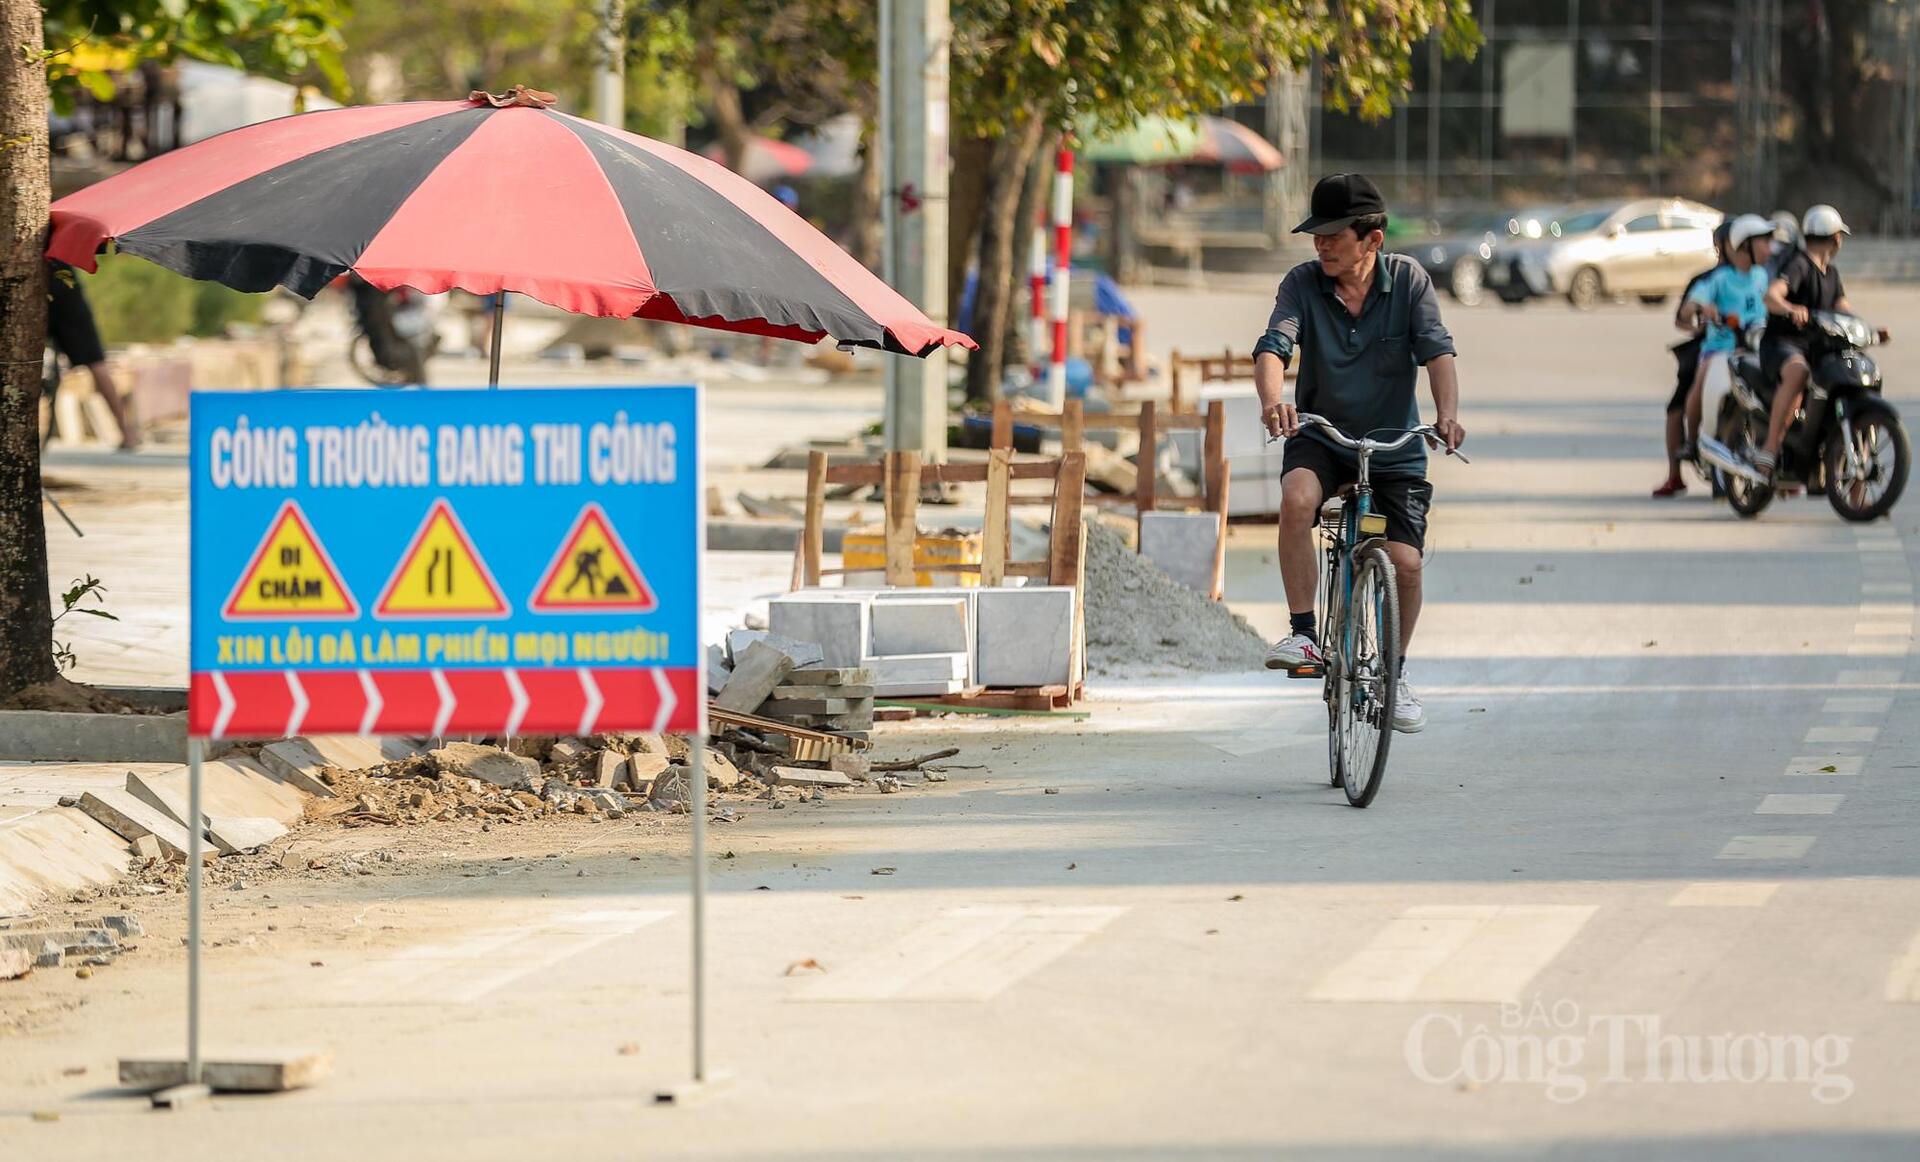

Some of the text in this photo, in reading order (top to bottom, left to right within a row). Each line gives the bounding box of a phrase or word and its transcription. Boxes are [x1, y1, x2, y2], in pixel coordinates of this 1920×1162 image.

[210, 409, 677, 489] CÔNG TRƯỜNG ĐANG THI CÔNG
[280, 547, 301, 567] ĐI
[259, 574, 323, 607] CHẬM
[217, 635, 265, 664] XIN
[362, 630, 420, 663] LÀM
[514, 632, 567, 667] MỌI
